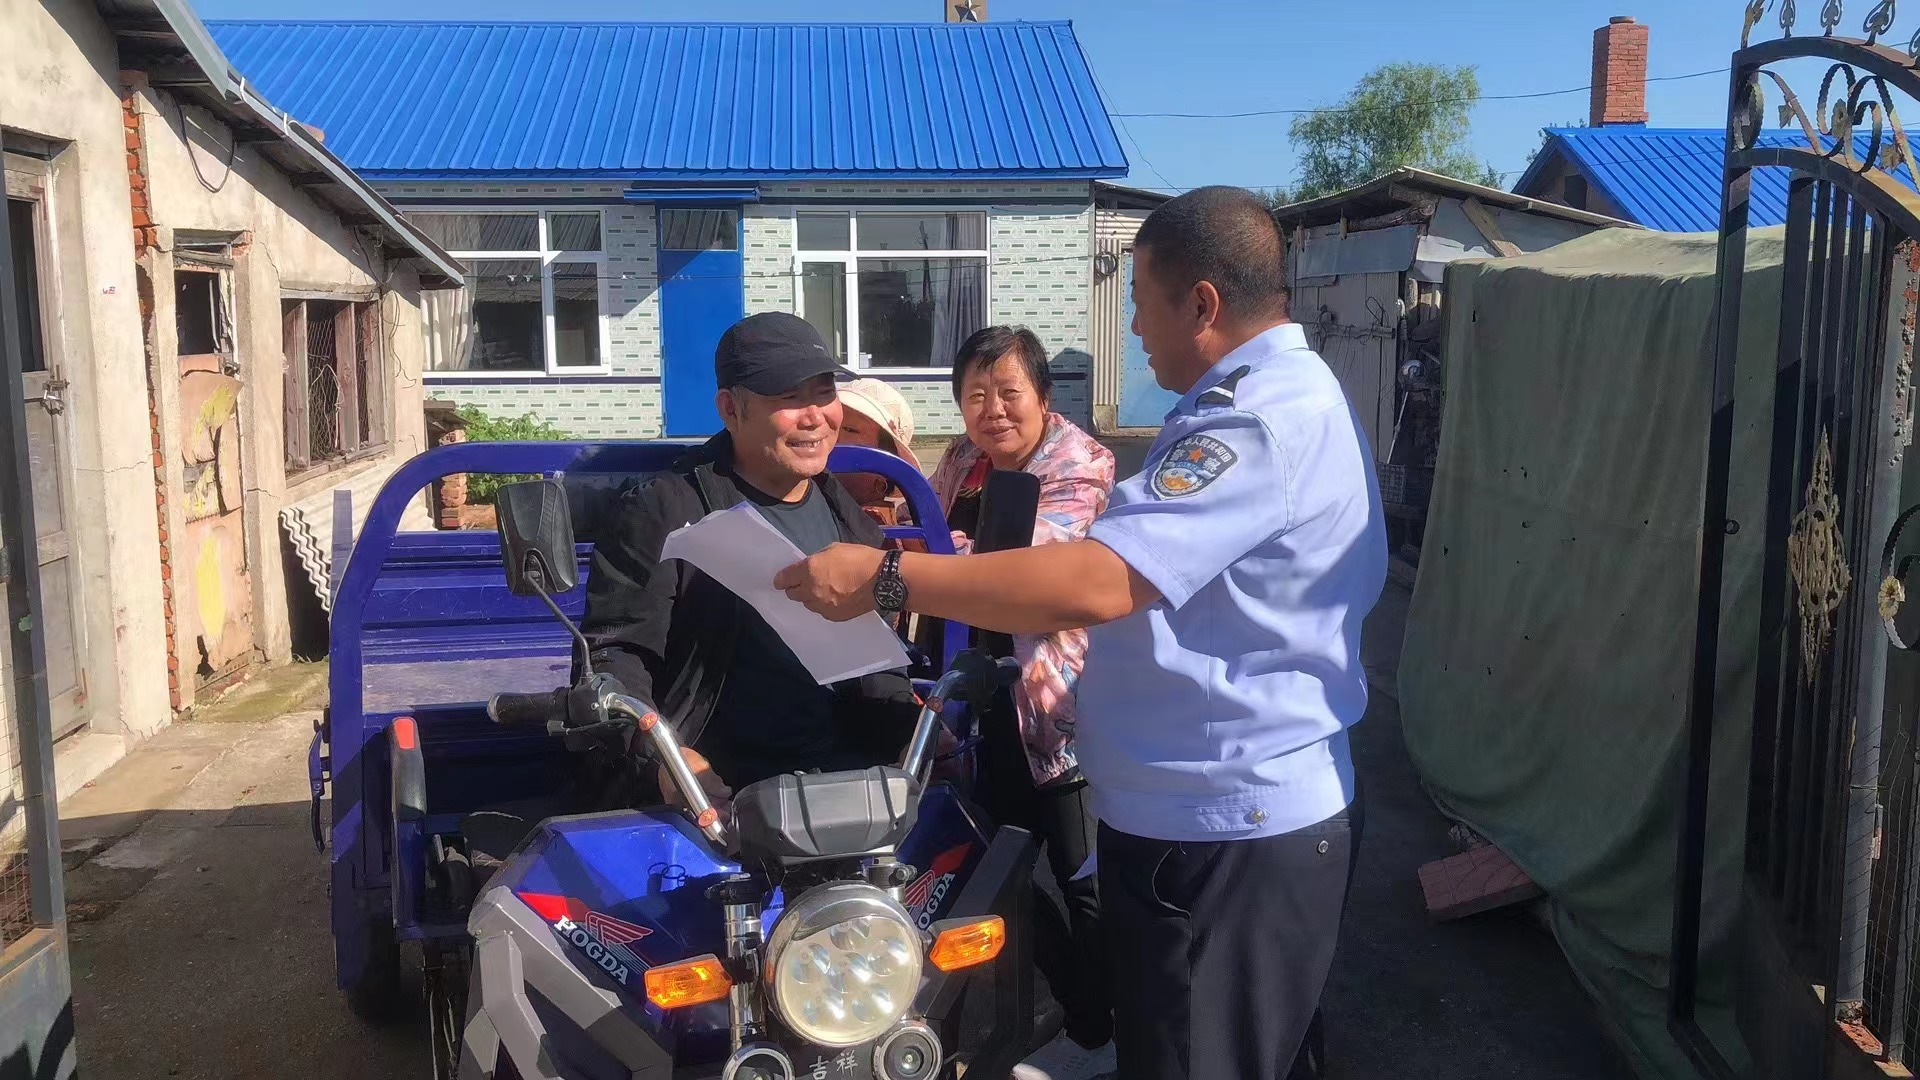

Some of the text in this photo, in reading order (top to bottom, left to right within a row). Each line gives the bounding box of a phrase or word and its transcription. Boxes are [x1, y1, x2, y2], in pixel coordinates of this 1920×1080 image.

[918, 873, 956, 929] OGDA
[553, 914, 629, 985] HOGDA
[808, 1049, 858, 1080] 吉祥
